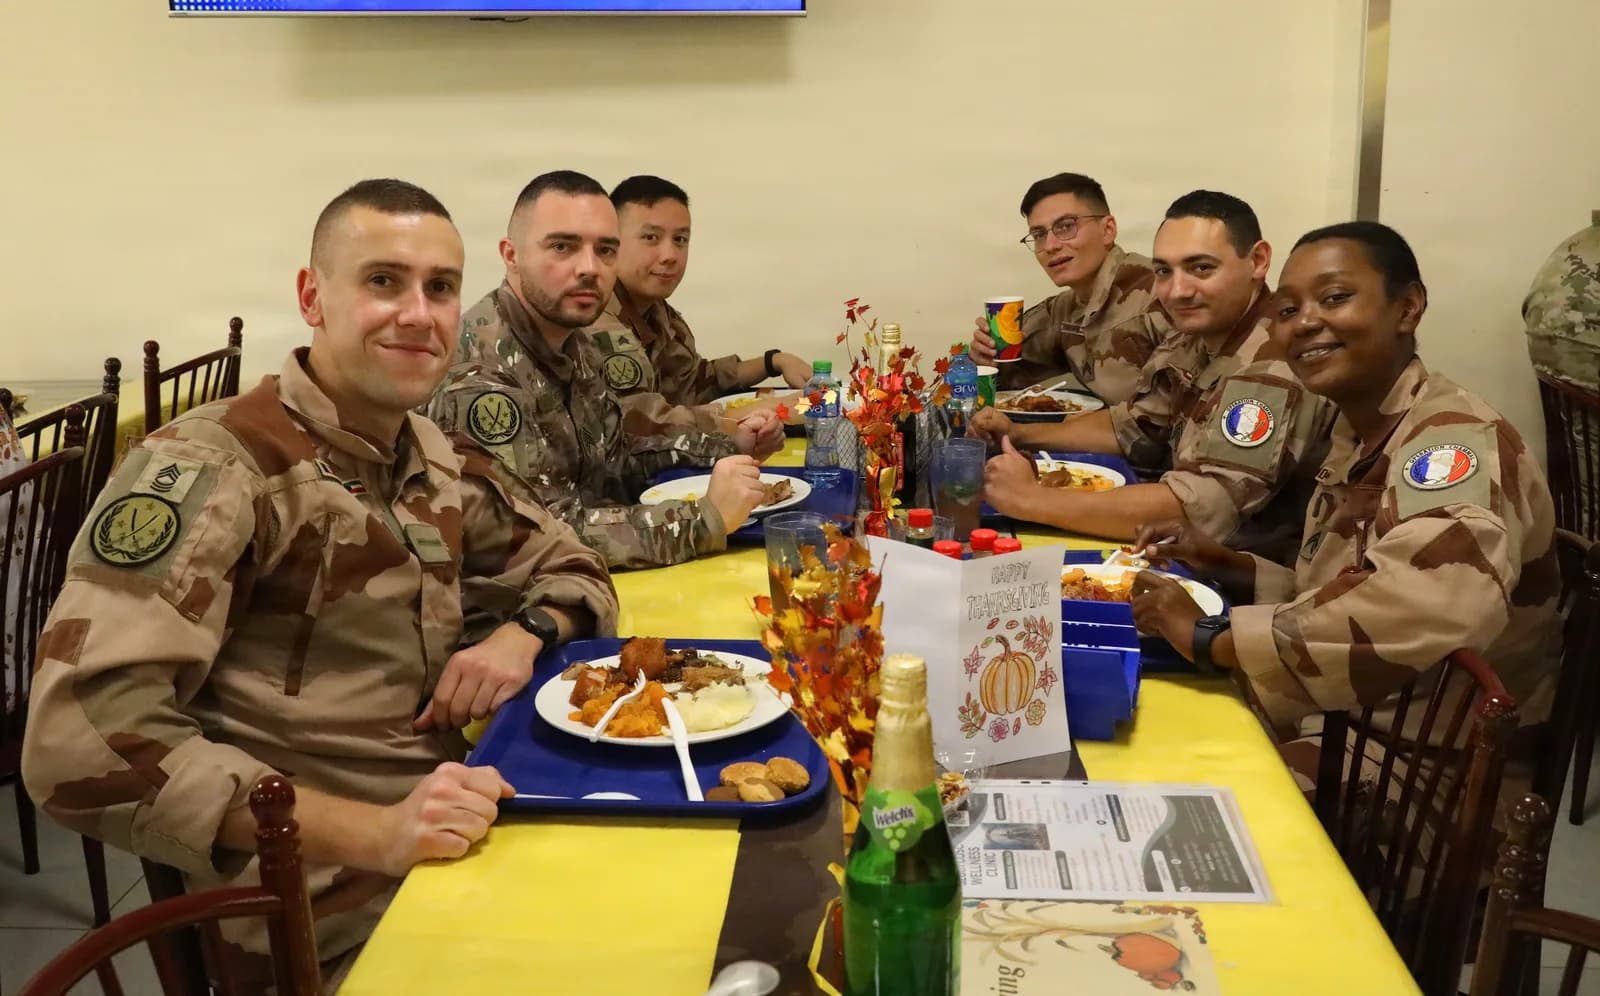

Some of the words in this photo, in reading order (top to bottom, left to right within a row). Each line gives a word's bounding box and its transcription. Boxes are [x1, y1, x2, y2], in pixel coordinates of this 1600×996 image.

[991, 561, 1032, 585] HAPPY
[966, 580, 1050, 621] THANKSGIVING
[968, 846, 982, 886] WELLNESS
[983, 852, 998, 878] CLINIC
[987, 965, 1026, 996] ing
